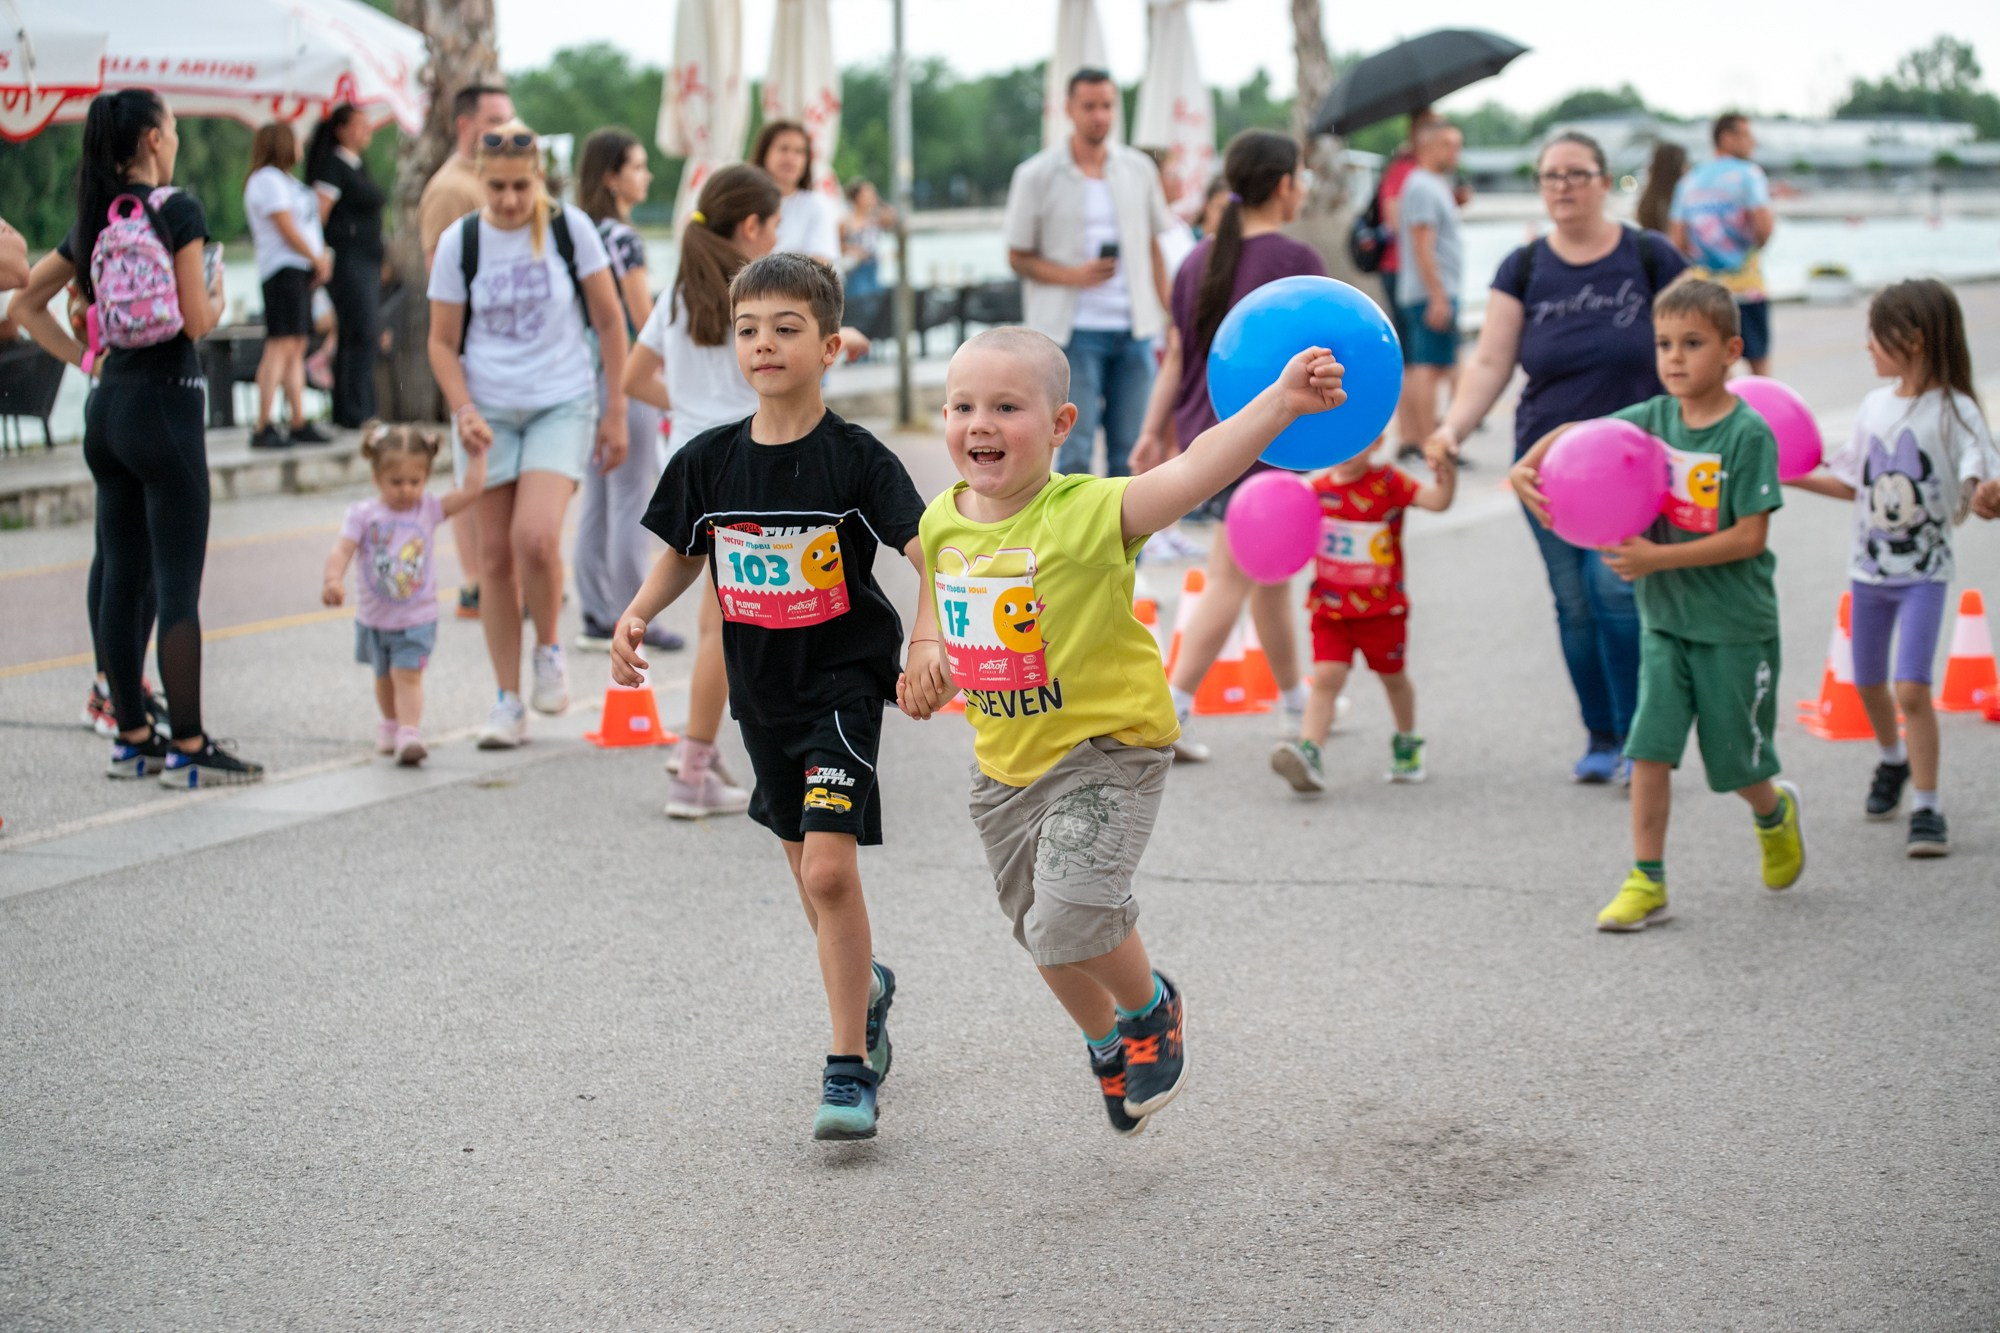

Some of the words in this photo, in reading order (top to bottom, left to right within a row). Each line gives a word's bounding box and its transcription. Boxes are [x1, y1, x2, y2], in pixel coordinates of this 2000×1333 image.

[1326, 533, 1354, 556] 22
[728, 551, 790, 586] 103
[944, 599, 970, 637] 17
